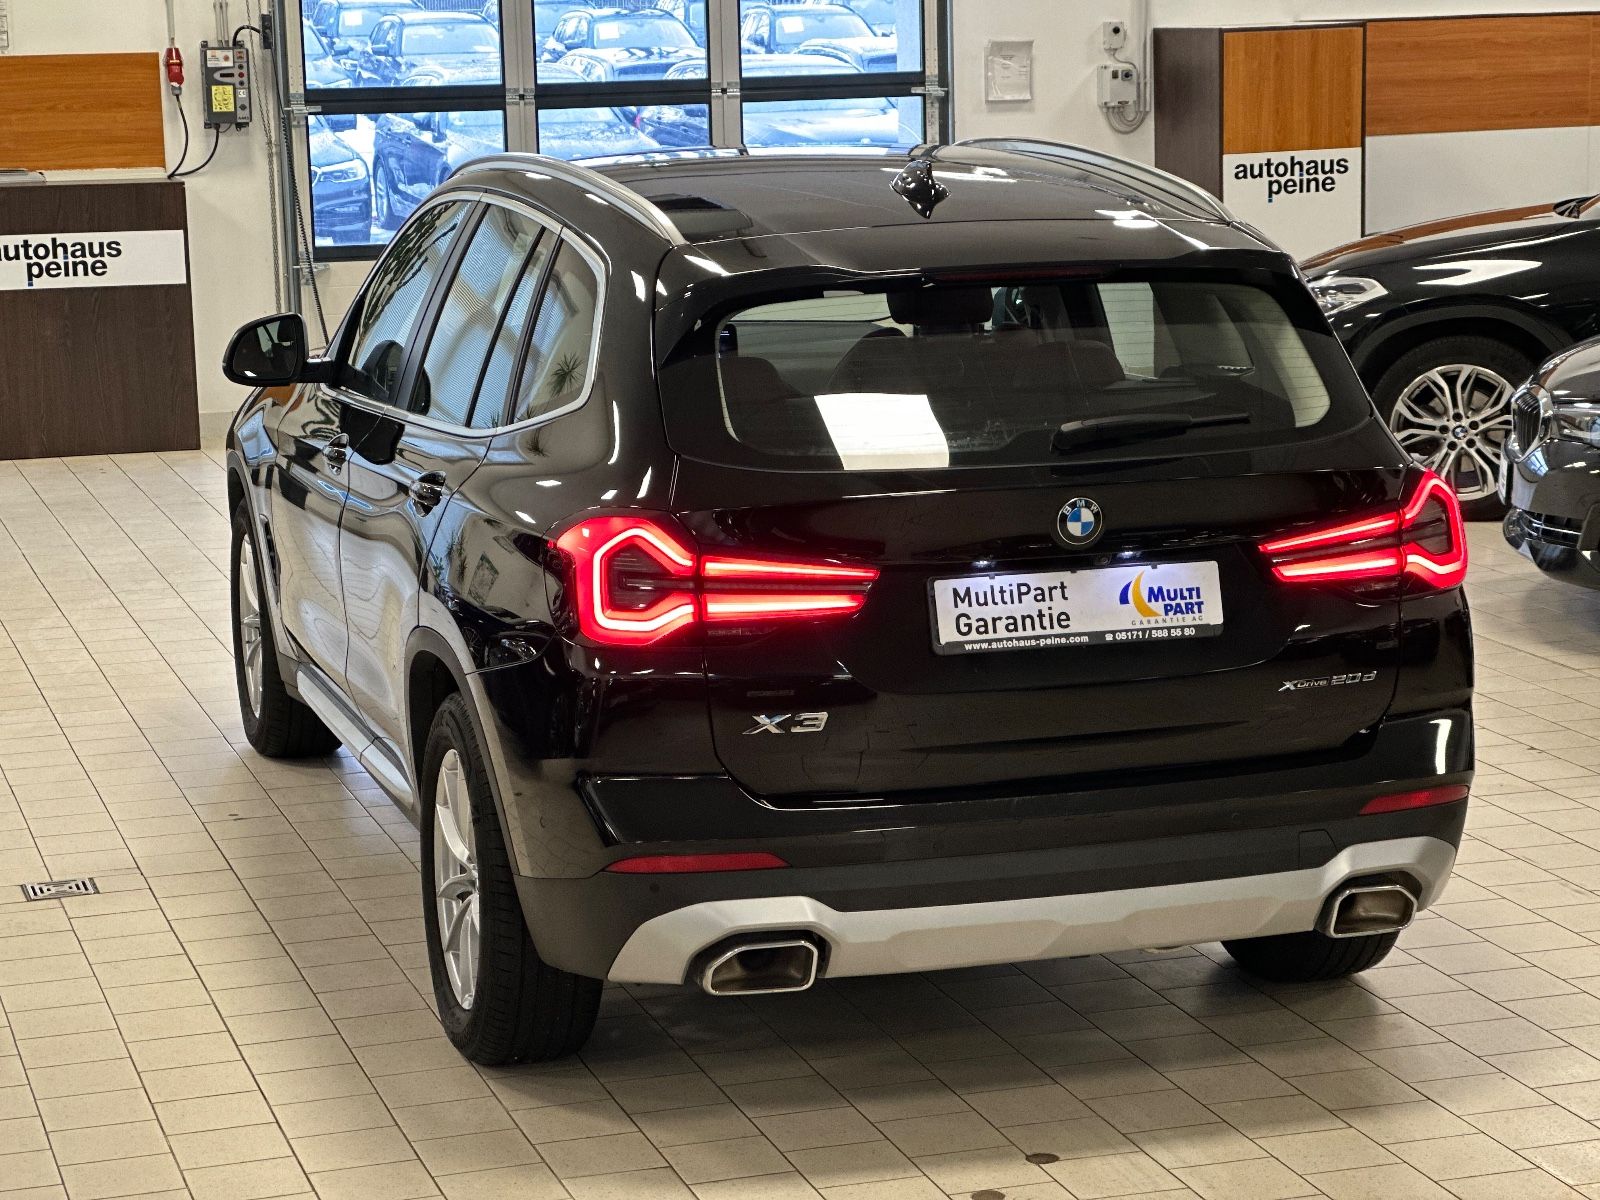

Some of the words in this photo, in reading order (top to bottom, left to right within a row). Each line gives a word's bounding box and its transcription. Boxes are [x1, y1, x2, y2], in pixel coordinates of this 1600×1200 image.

[1234, 156, 1349, 180] autohaus
[1268, 176, 1336, 203] peine
[0, 237, 122, 262] utohaus
[26, 259, 108, 287] peine
[1062, 499, 1099, 516] BMW
[952, 581, 1068, 608] MultiPart
[1147, 585, 1201, 603] MULTI
[1163, 601, 1204, 616] PART
[955, 606, 1071, 636] Garantie
[1131, 616, 1187, 626] GARANTIE
[964, 634, 1089, 651] www.autohaus-peine.com
[1115, 630, 1143, 640] 05171
